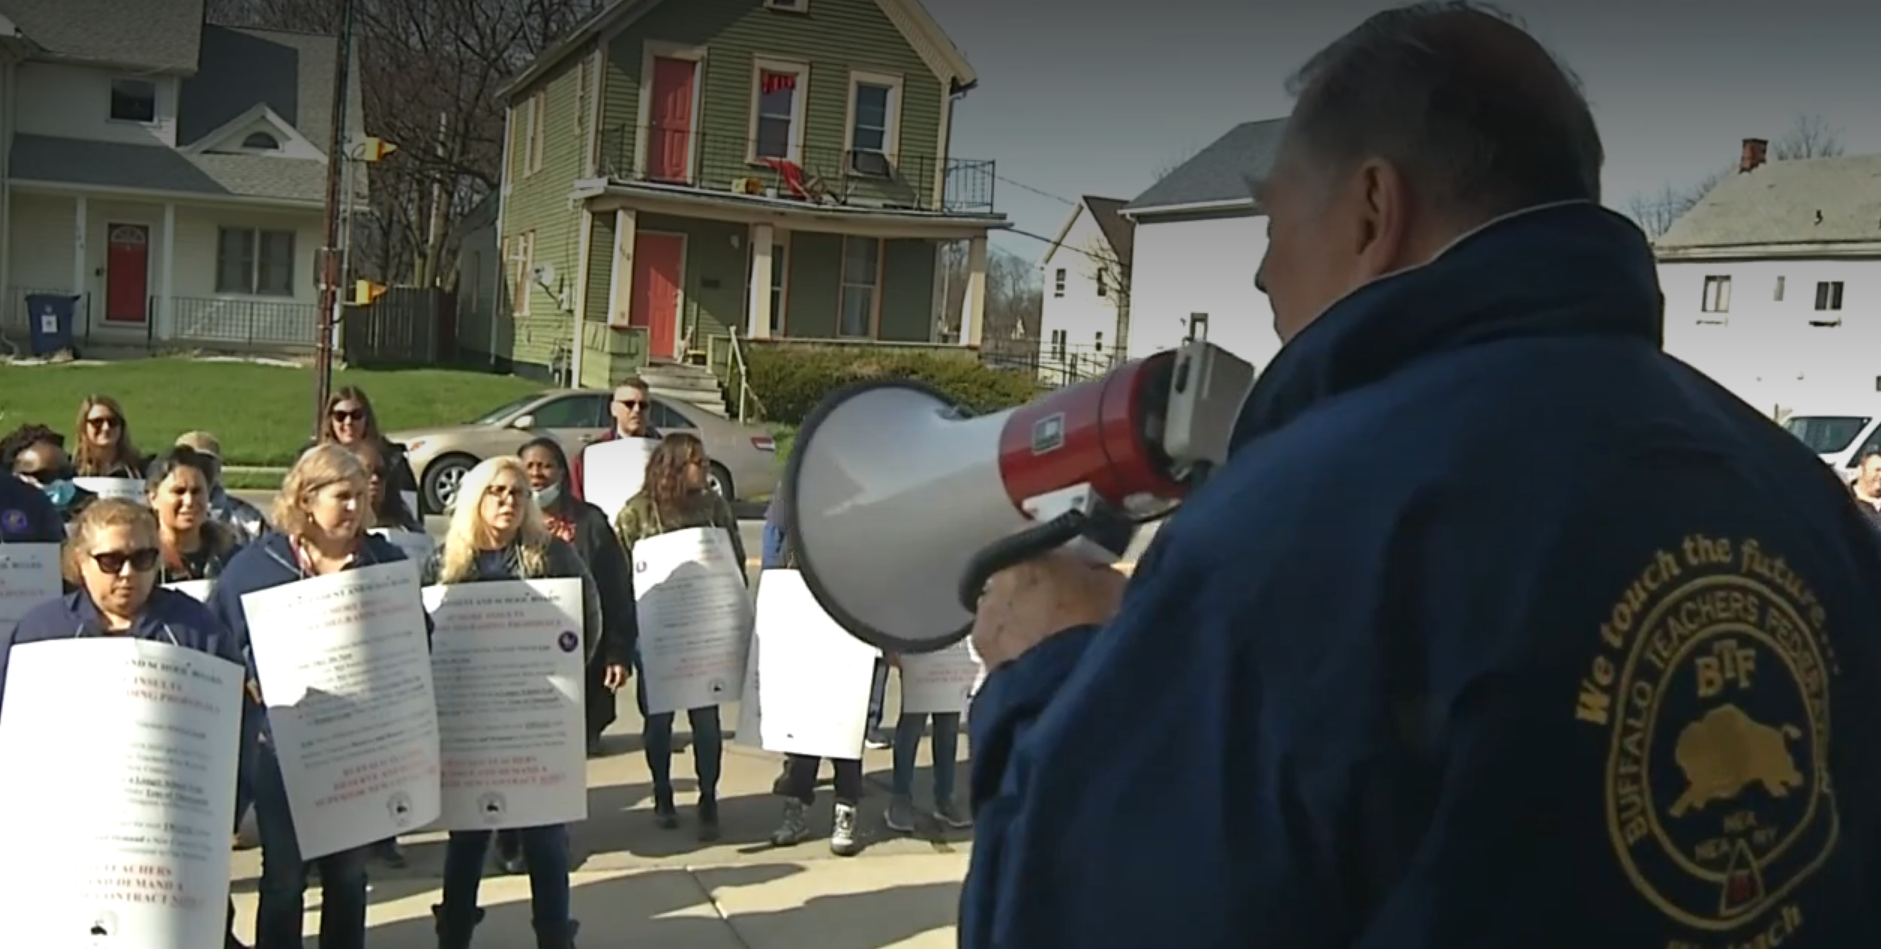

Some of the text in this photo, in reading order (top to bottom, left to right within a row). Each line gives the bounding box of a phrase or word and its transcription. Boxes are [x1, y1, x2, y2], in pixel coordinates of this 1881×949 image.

[1575, 653, 1615, 725] We
[1600, 547, 1682, 649] touch
[1681, 533, 1733, 565] the
[1618, 679, 1653, 846] BUFFALO
[1643, 590, 1761, 670] TEACHERS
[1694, 638, 1757, 698] BTF
